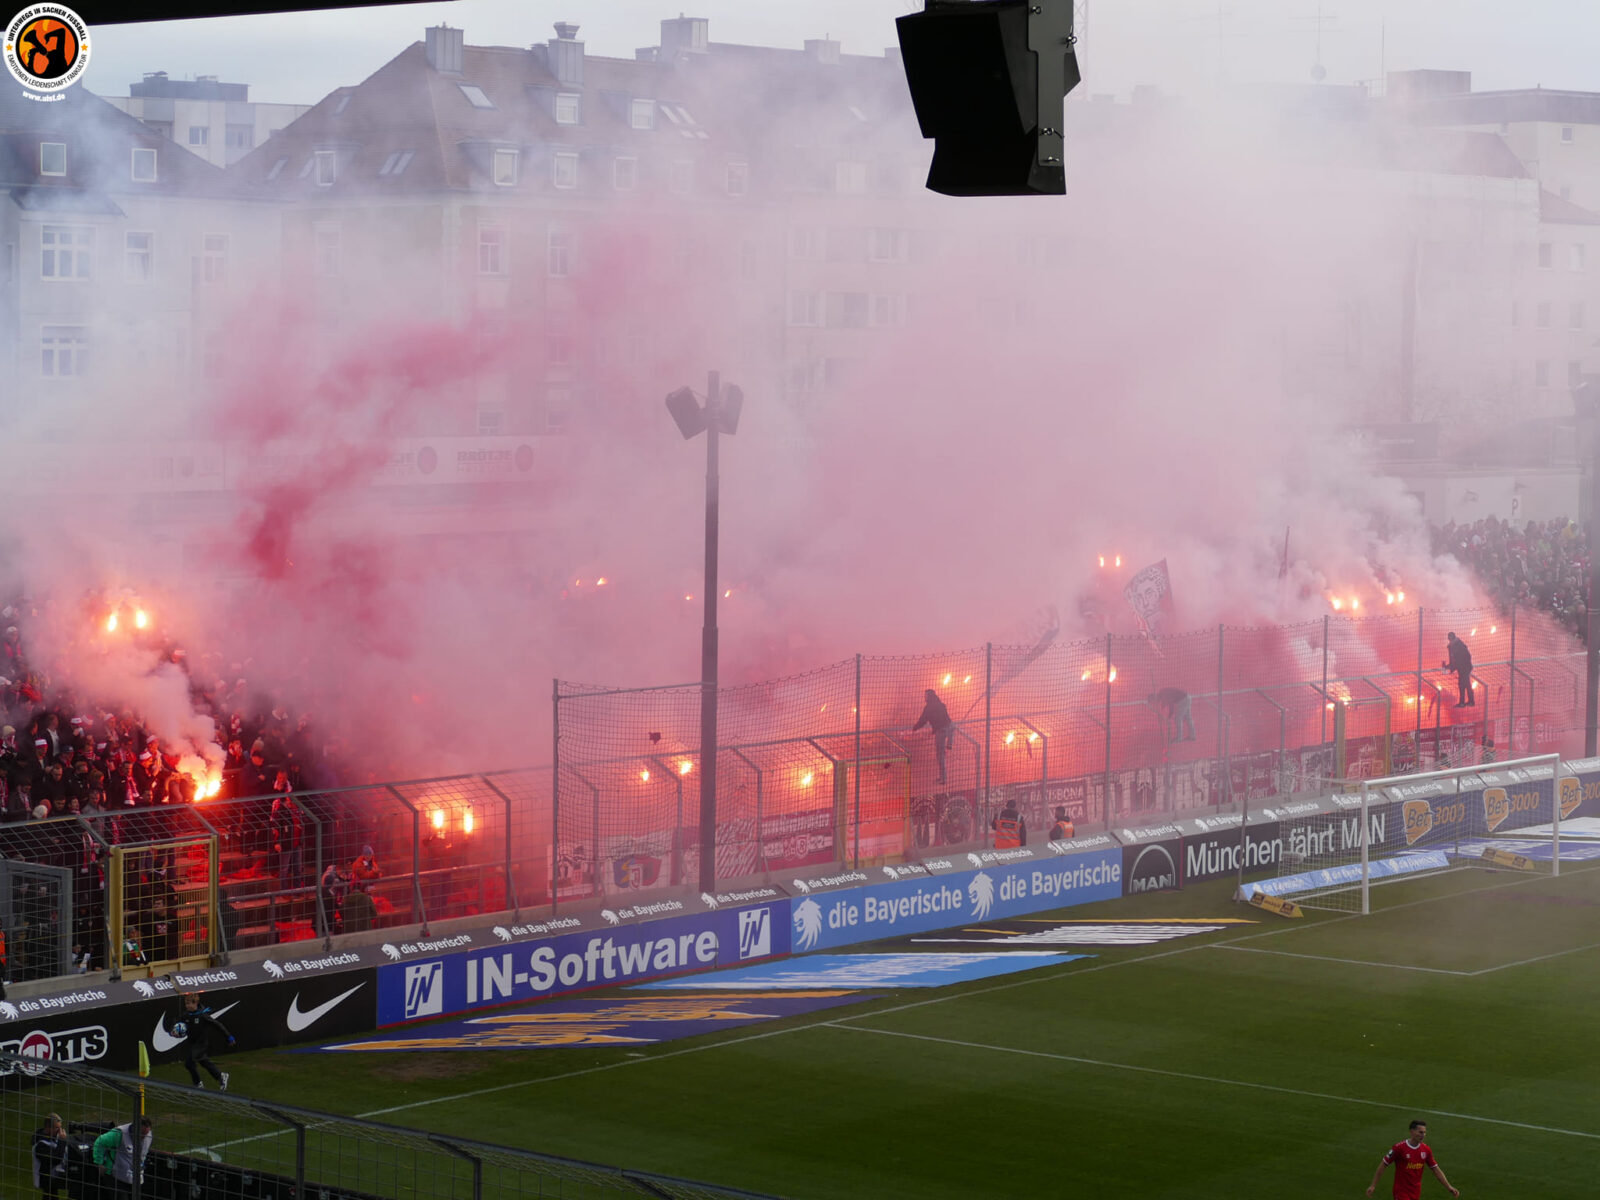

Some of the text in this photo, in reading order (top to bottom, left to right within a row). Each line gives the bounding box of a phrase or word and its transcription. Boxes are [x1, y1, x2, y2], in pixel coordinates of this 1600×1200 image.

[1487, 792, 1540, 816] Bet 3000
[1407, 808, 1433, 829] Bet
[1186, 836, 1283, 878] München
[1289, 823, 1336, 858] fährt
[808, 871, 868, 889] die Bayerische
[1000, 858, 1121, 902] die Bayerische
[1132, 872, 1172, 892] MAN
[716, 886, 777, 904] die Bayerische
[618, 898, 682, 920] die Bayerische
[828, 884, 963, 930] die Bayerische
[512, 916, 581, 936] die Bayerische
[401, 933, 472, 955] die Bayerische
[284, 952, 360, 974] die Bayerische
[466, 930, 719, 1005] IN-Software
[154, 970, 238, 992] die Bayerische
[19, 990, 107, 1013] die Bayerische
